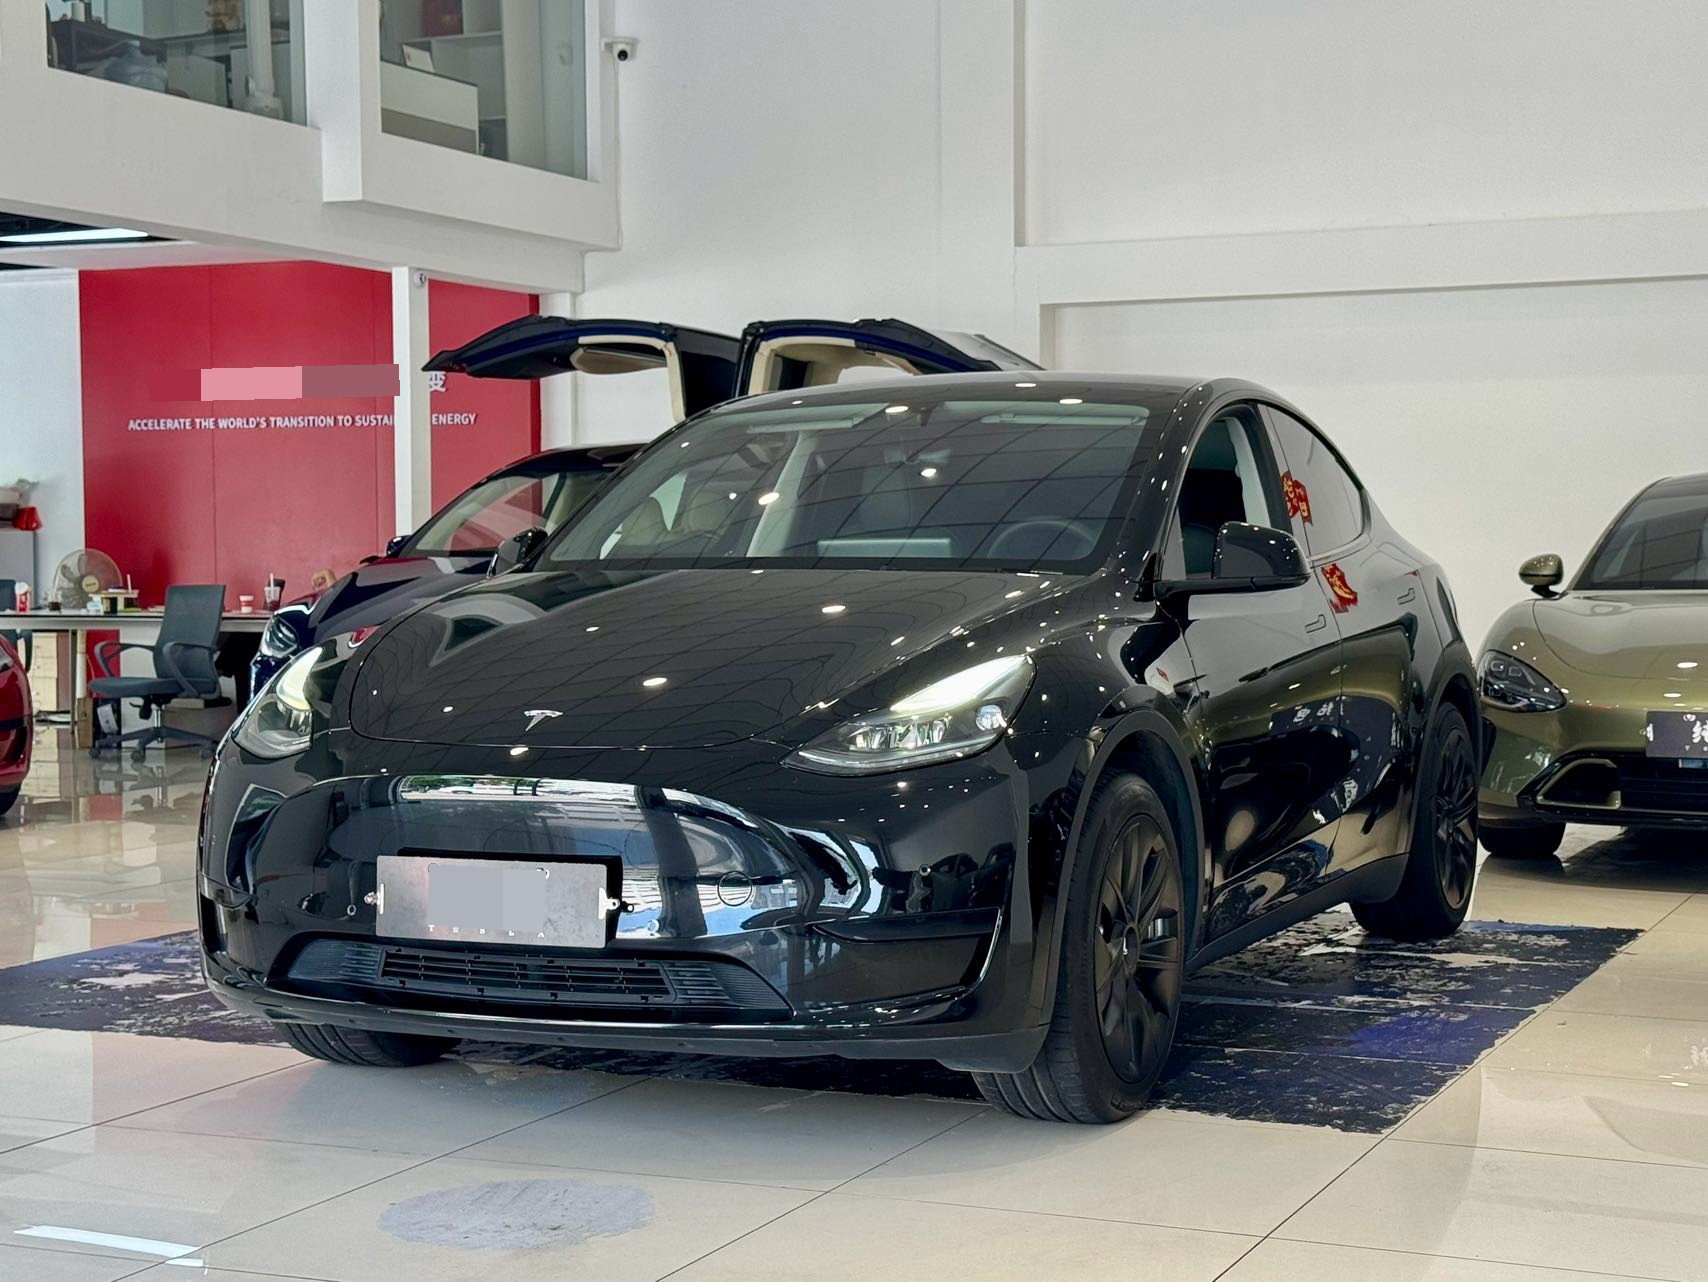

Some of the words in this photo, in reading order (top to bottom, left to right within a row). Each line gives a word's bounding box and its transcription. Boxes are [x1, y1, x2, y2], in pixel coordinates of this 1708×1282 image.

[128, 418, 192, 431] ACCELERATE
[195, 417, 215, 429] THE
[217, 416, 267, 429] WORLD'S
[269, 415, 333, 428] TRANSITION
[337, 415, 352, 427] TO
[355, 414, 393, 427] SUSTAI
[431, 412, 477, 425] ENERGY
